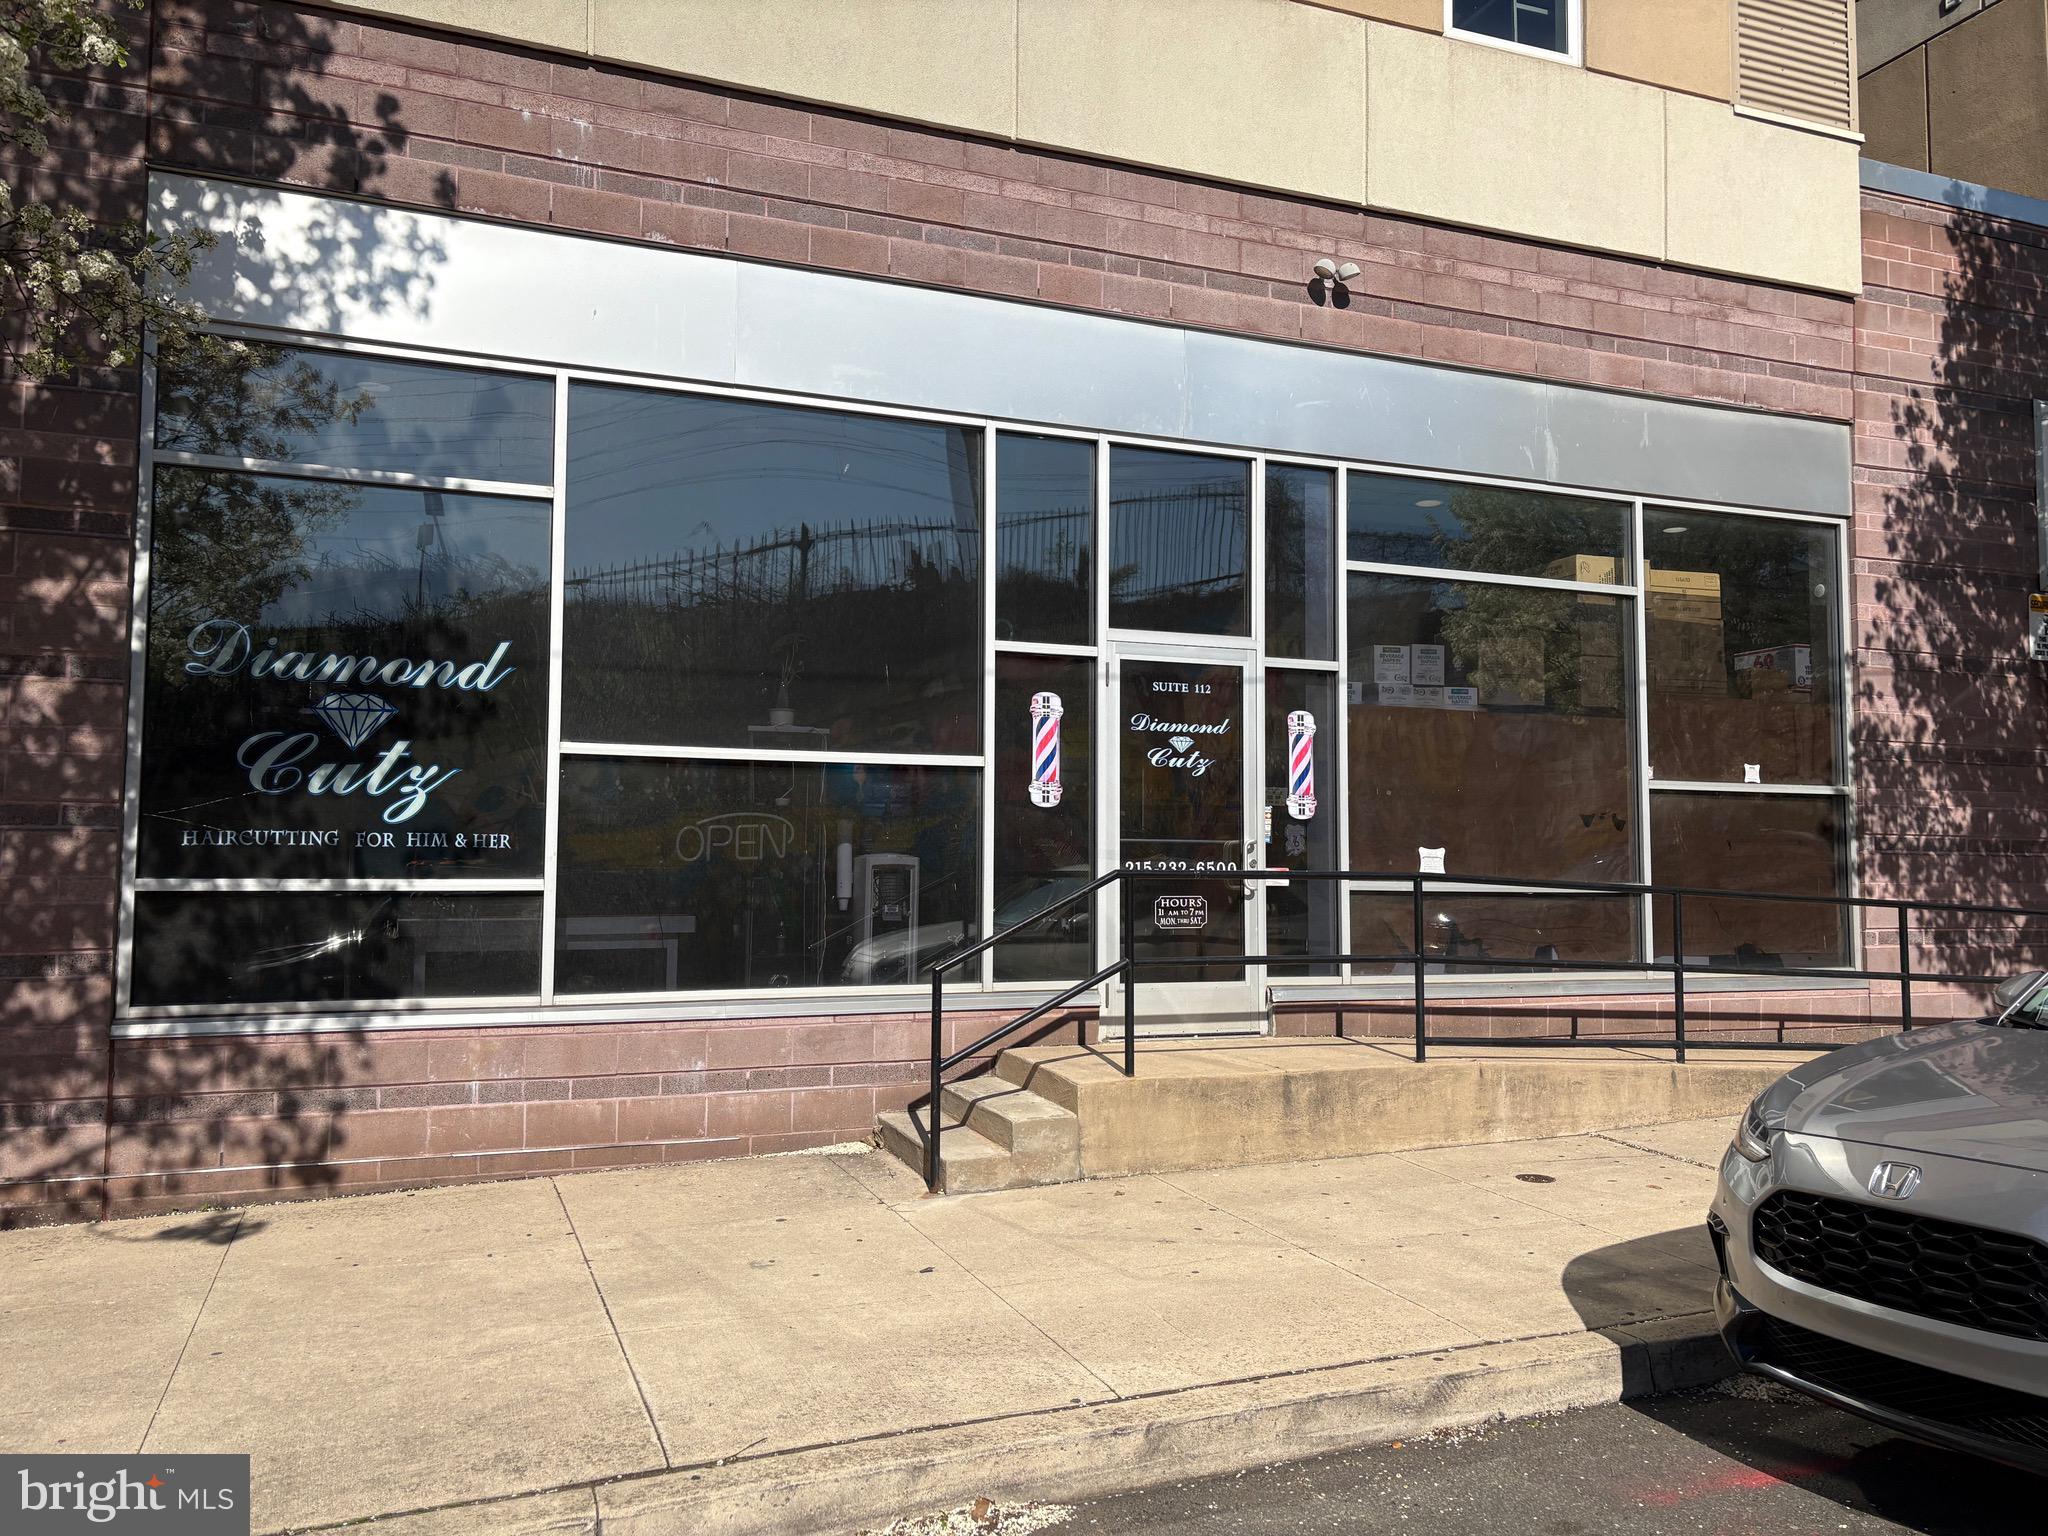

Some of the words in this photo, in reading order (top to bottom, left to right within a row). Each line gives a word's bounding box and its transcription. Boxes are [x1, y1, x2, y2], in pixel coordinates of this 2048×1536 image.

[184, 619, 516, 692] Diamond
[1152, 681, 1189, 693] SUITE
[1194, 684, 1211, 694] 112
[1130, 713, 1231, 735] Diamond
[1147, 747, 1216, 777] Cutz
[236, 731, 462, 824] Cutz
[181, 829, 339, 847] HAIRCUTTING
[355, 831, 396, 848] FOR
[406, 831, 448, 848] HIM
[454, 832, 468, 848] &
[472, 833, 512, 849] HER
[676, 823, 787, 862] OPEN
[1161, 899, 1201, 907] HOURS
